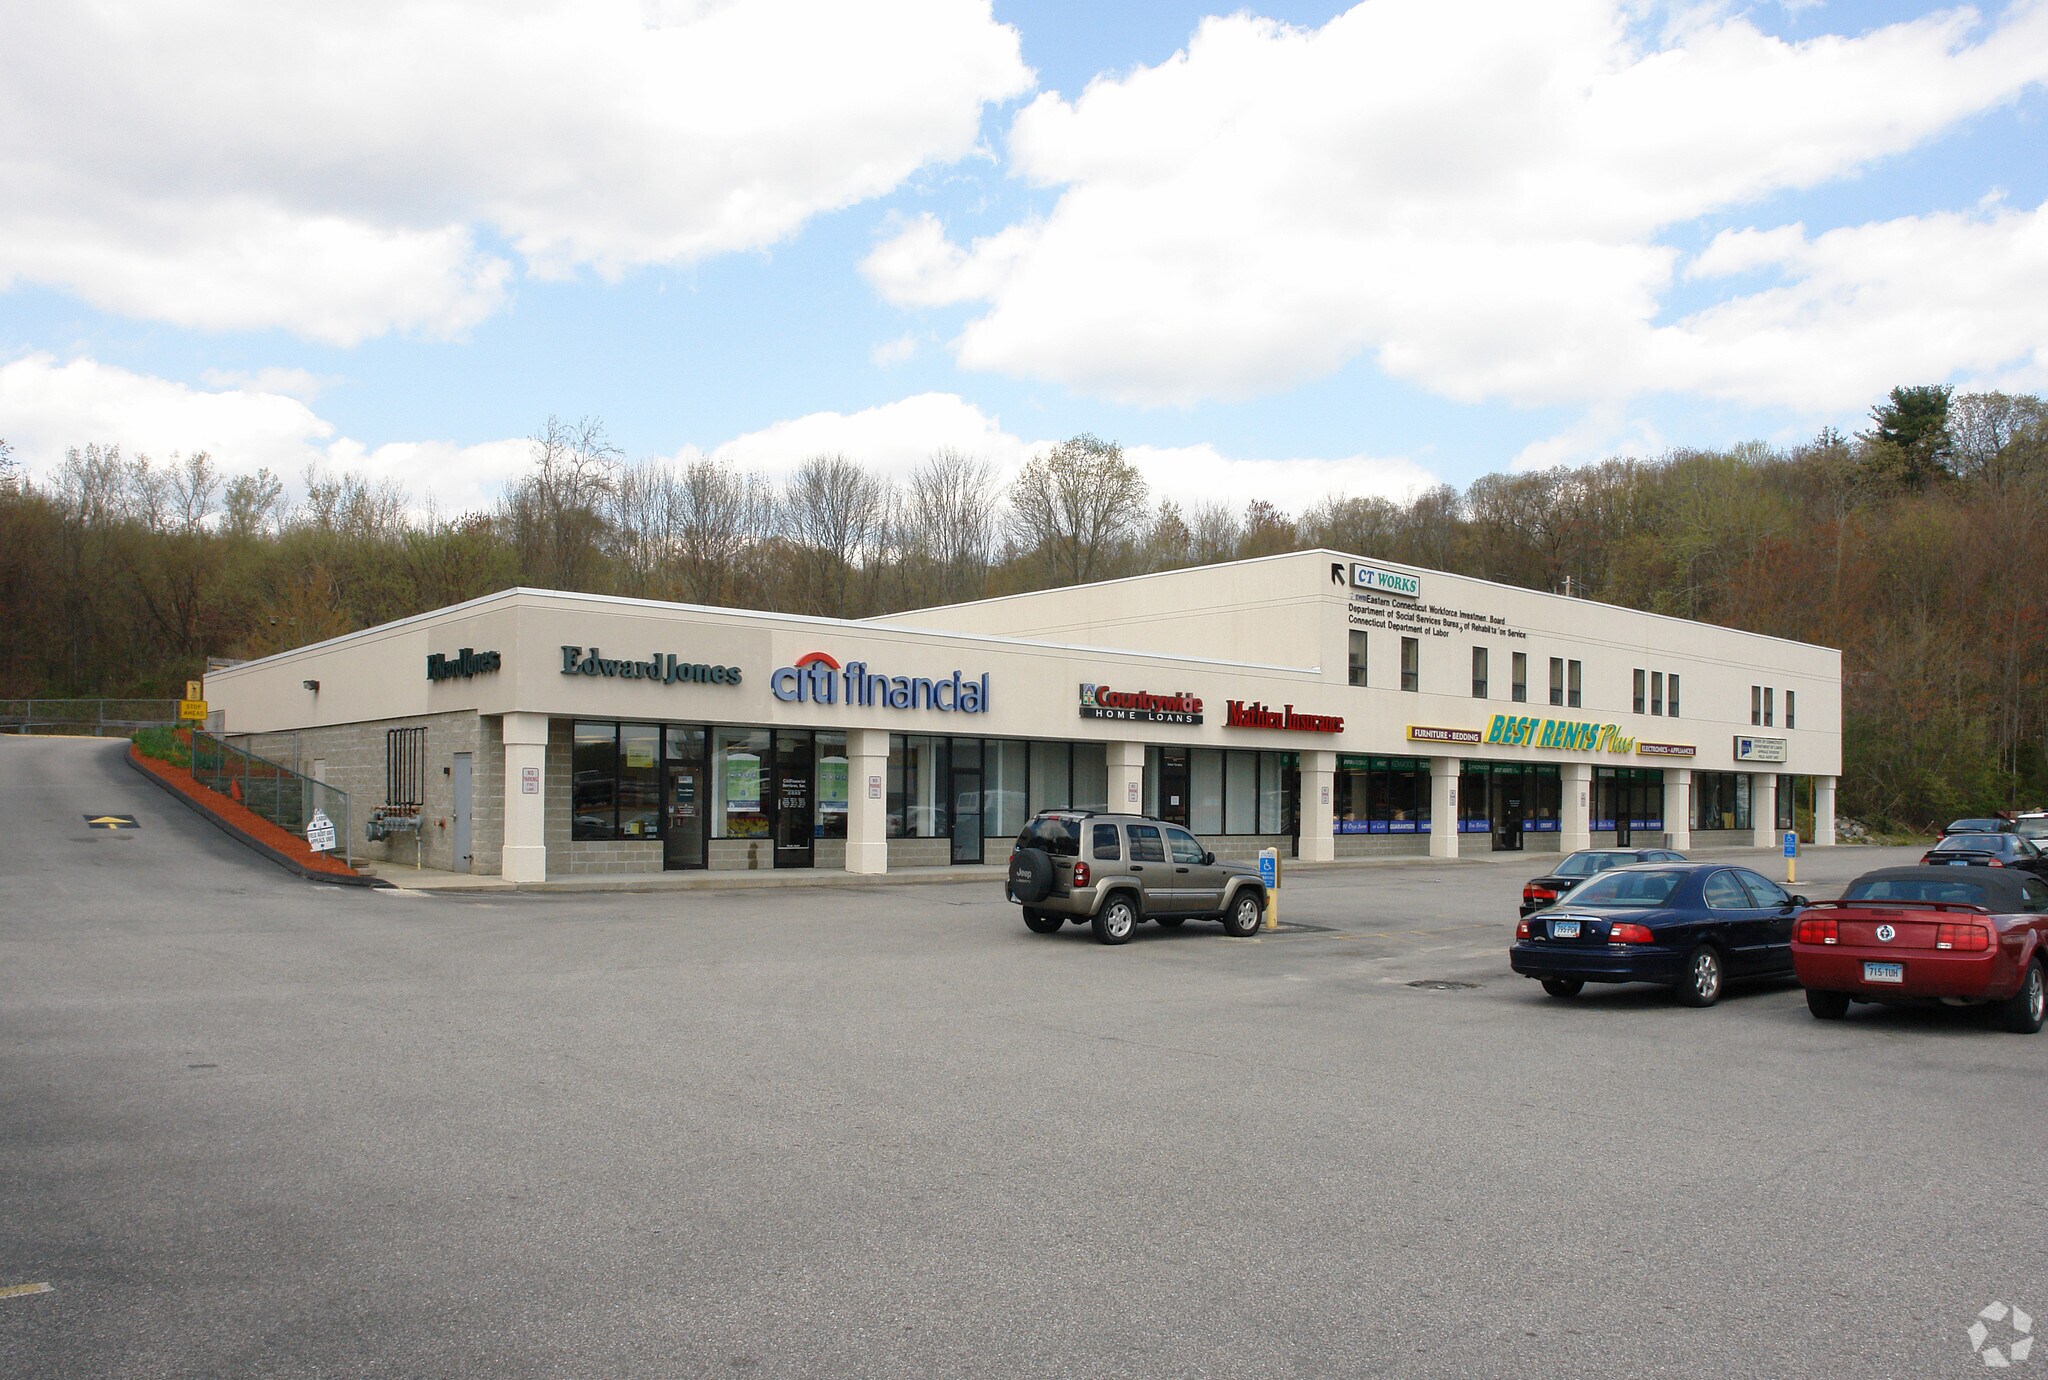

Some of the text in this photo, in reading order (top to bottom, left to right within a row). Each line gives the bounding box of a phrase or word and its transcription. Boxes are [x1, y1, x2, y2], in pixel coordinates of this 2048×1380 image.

[1359, 569, 1417, 593] CT WORKS
[1348, 603, 1385, 617] Department
[1387, 610, 1394, 618] of
[1396, 611, 1415, 622] Social
[1416, 614, 1441, 626] Services
[1508, 629, 1526, 639] Service
[1366, 595, 1391, 606] Eastern
[1392, 599, 1427, 613] Connecticut
[1429, 604, 1458, 617] Workforce
[1489, 615, 1505, 625] Board
[1348, 614, 1449, 637] Connecticut Department of Labor
[1095, 685, 1203, 713] Countrywide
[1095, 709, 1193, 723] HOME LOANS
[1284, 704, 1345, 733] Insurance
[1414, 728, 1479, 741] FURNITURE BEDDING
[1485, 714, 1635, 753] BEST RENTS Plus
[1641, 745, 1668, 753] ELECTRONICS
[1016, 868, 1032, 879] Jeep
